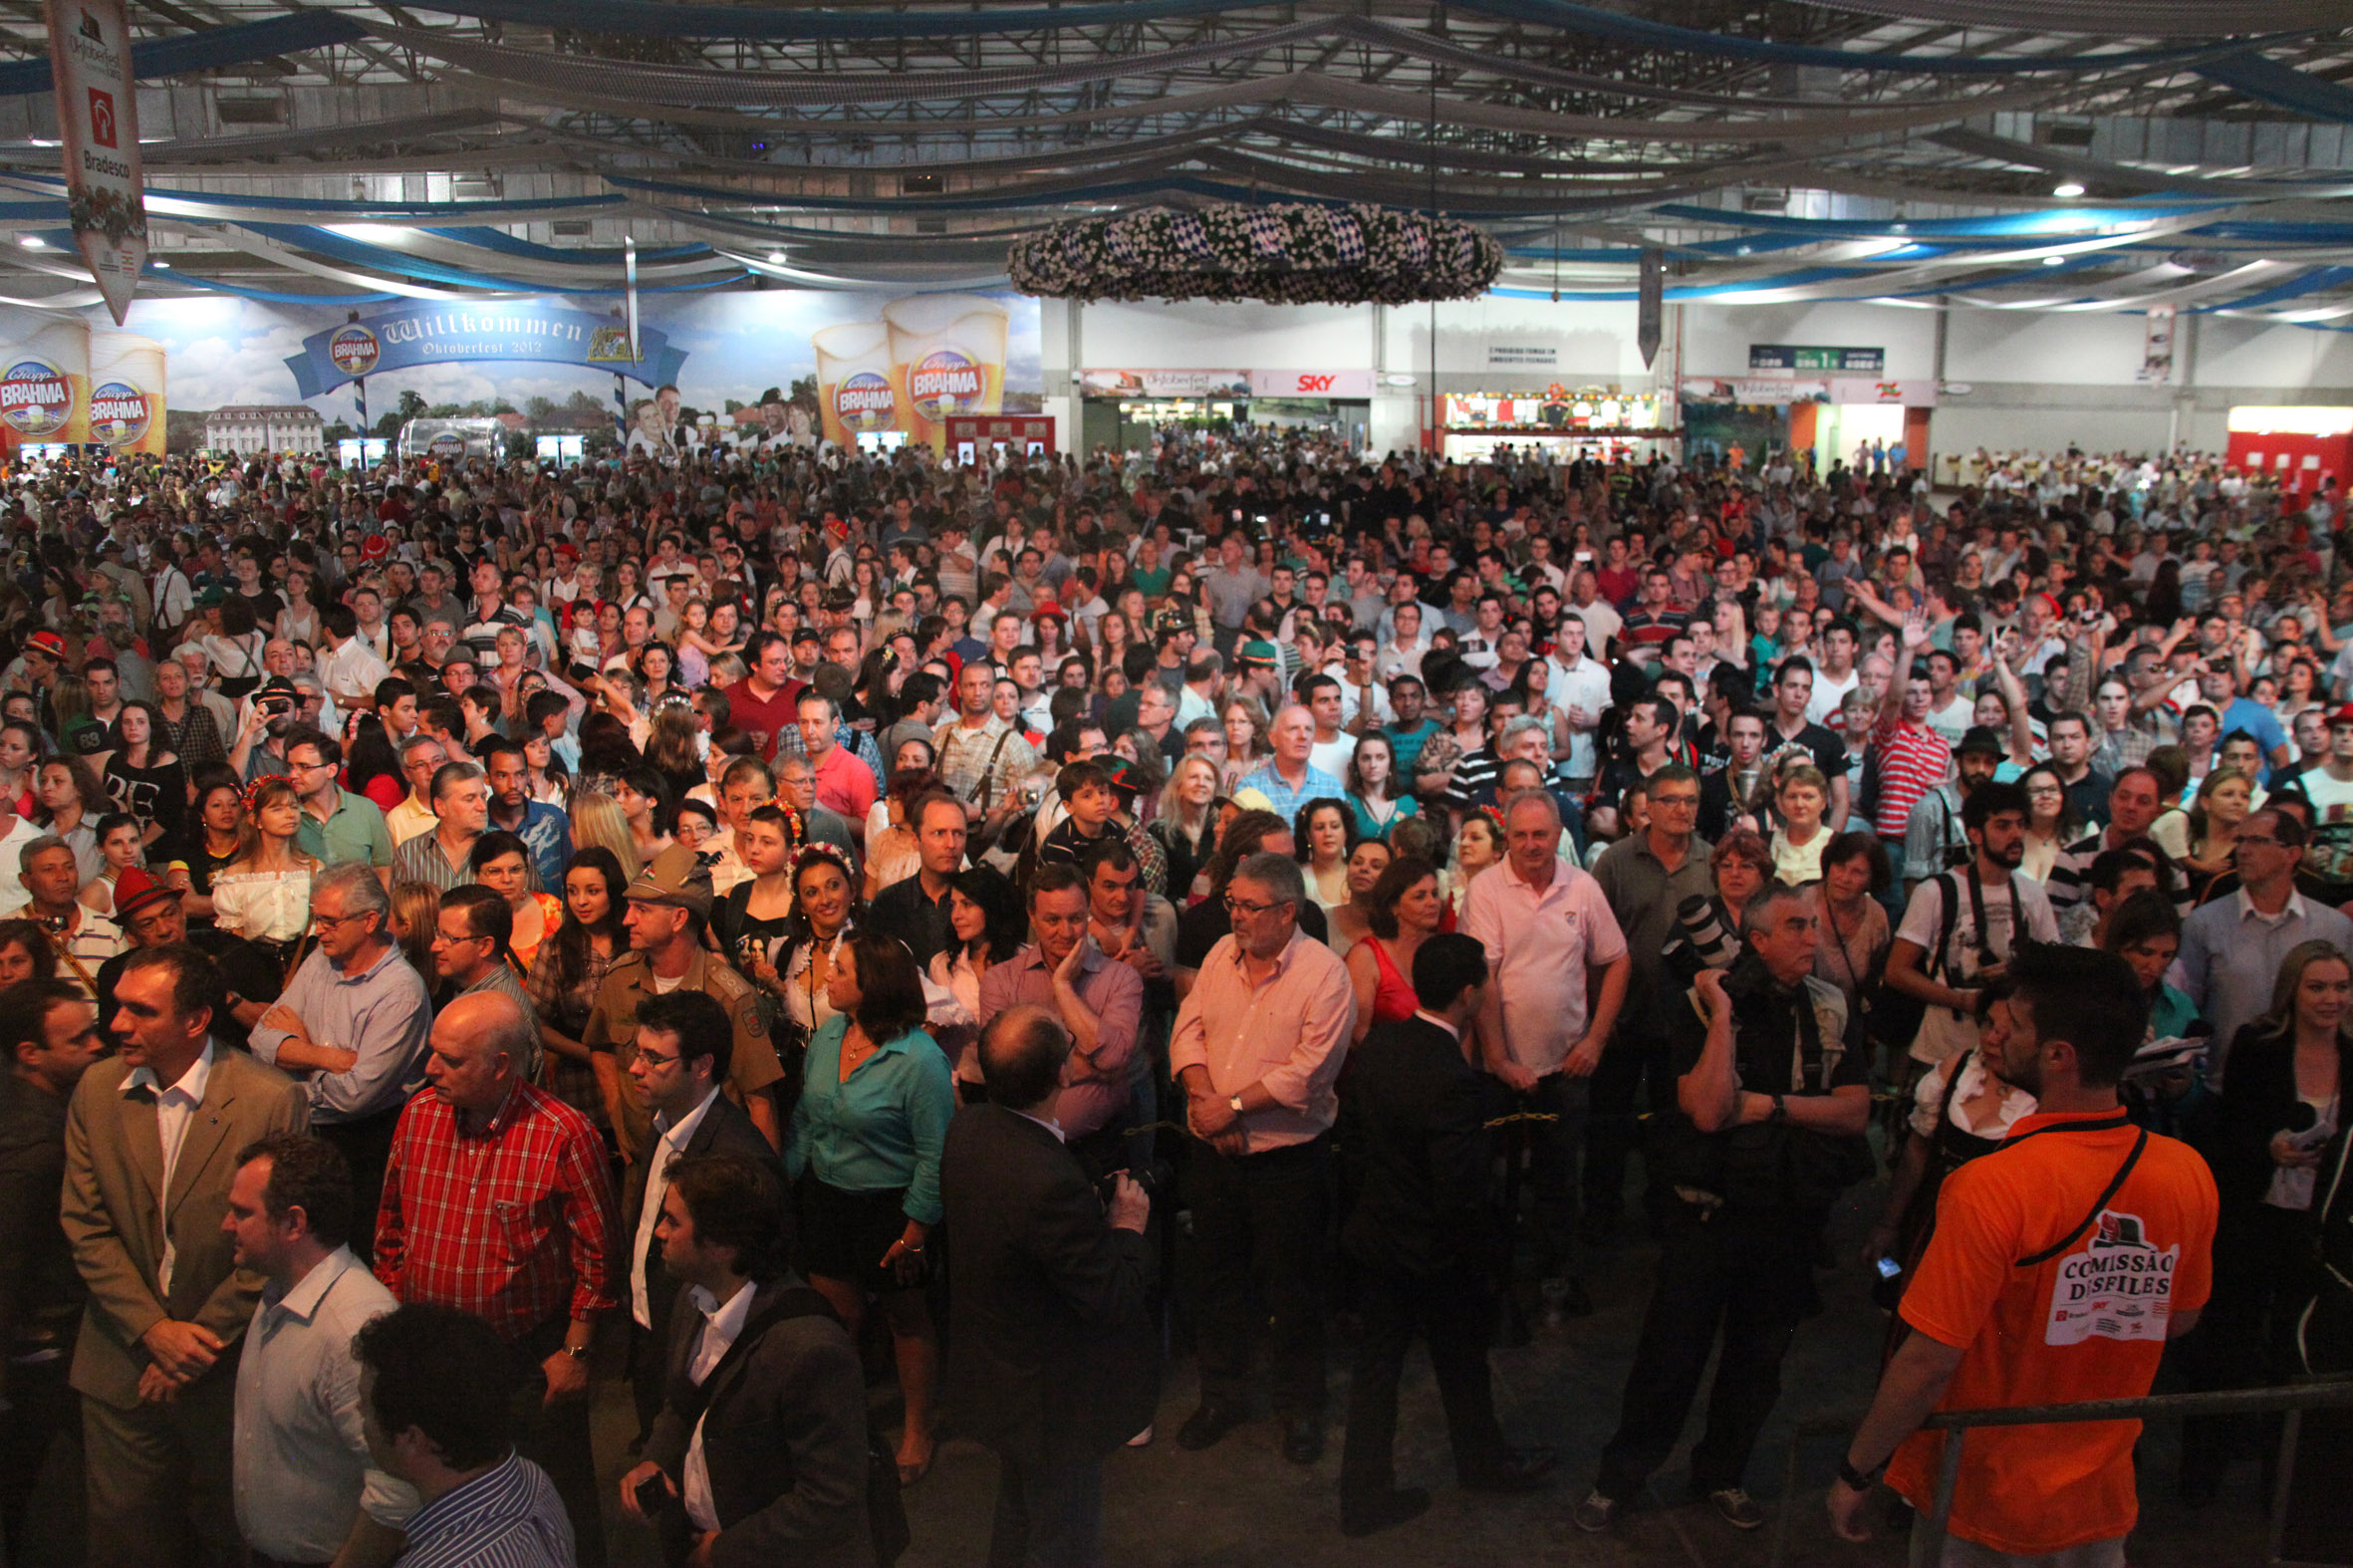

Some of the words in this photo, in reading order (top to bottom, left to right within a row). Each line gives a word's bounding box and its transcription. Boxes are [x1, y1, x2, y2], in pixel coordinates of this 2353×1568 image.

[84, 149, 130, 179] Bradesco
[383, 312, 583, 344] Willkommen
[334, 342, 376, 360] BRAHMA
[422, 341, 503, 356] Oktoberfest
[511, 341, 542, 354] 2012
[8, 370, 56, 382] Chopp
[921, 359, 971, 372] Chopp
[1, 382, 66, 407] BRAHMA
[96, 389, 136, 400] Chopp
[914, 372, 978, 396] BRAHMA
[1297, 375, 1337, 392] SKY
[92, 399, 144, 421] BRAHMA
[840, 390, 895, 412] BRAHMA
[2064, 1250, 2174, 1279] COMISSÃO
[2069, 1275, 2170, 1300] DSFILES
